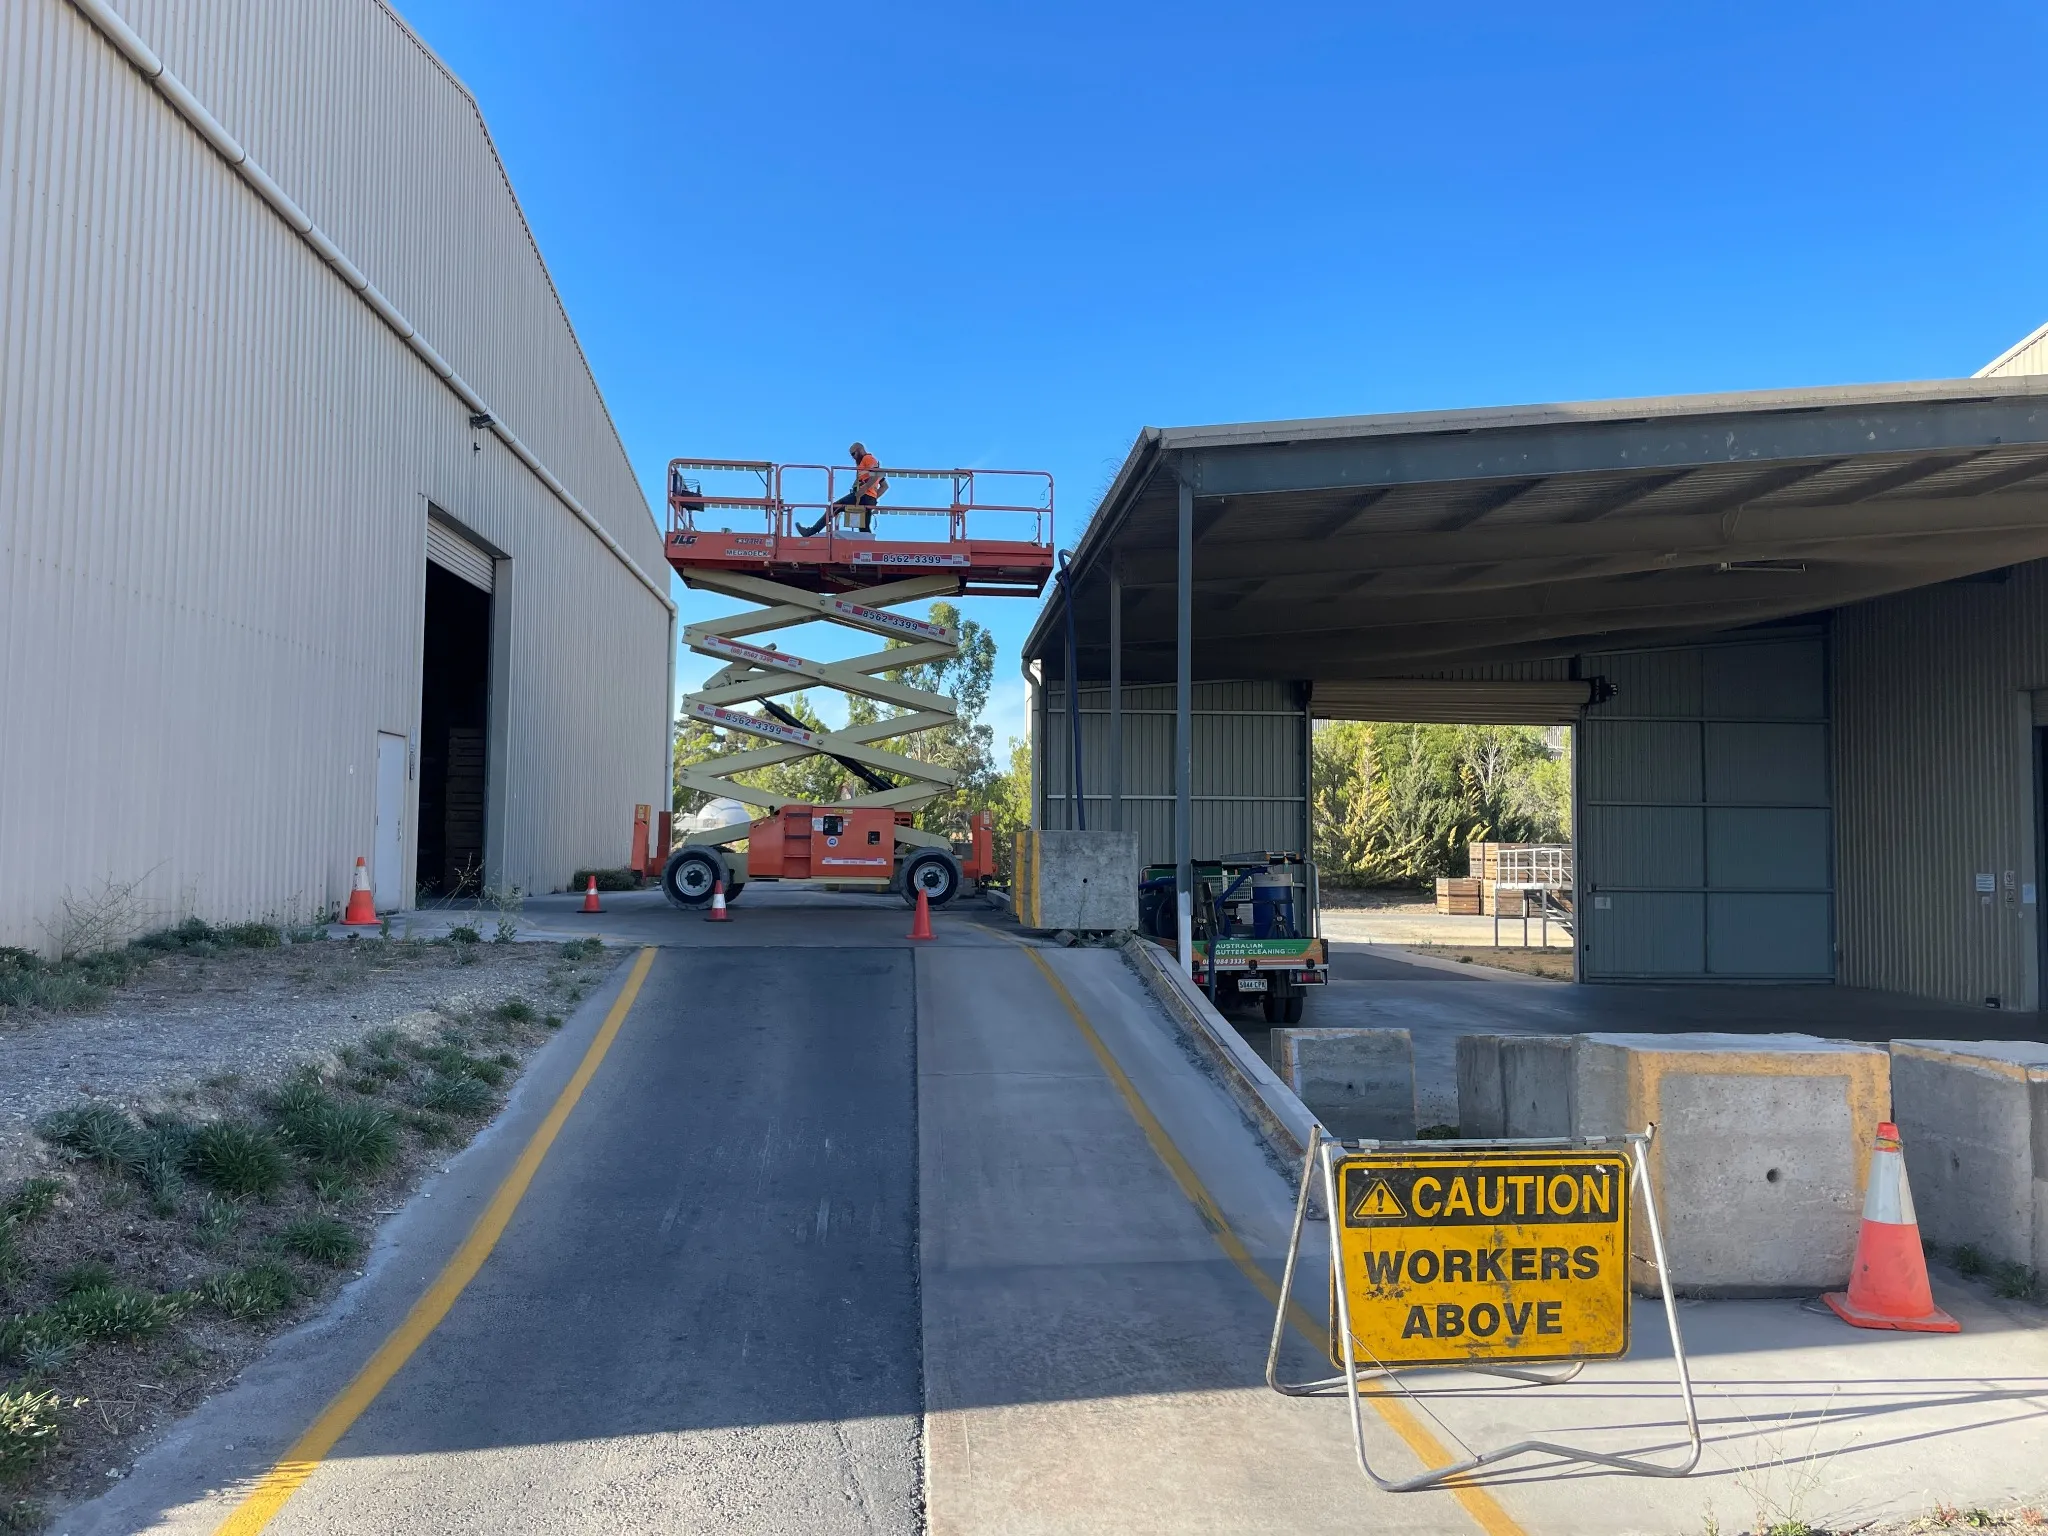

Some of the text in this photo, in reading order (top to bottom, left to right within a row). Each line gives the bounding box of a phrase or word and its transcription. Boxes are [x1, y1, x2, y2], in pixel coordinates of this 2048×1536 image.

[671, 535, 698, 545] JLG
[726, 549, 768, 557] MEGADECK
[883, 553, 910, 563] 8562
[914, 555, 941, 564] 3399
[862, 609, 888, 623] 8562
[892, 618, 918, 631] 3399
[725, 713, 752, 727] 8562
[755, 721, 782, 735] 3399
[1411, 1174, 1610, 1218] CAUTION
[1363, 1245, 1600, 1285] WORKERS
[1401, 1301, 1563, 1339] ABOVE
